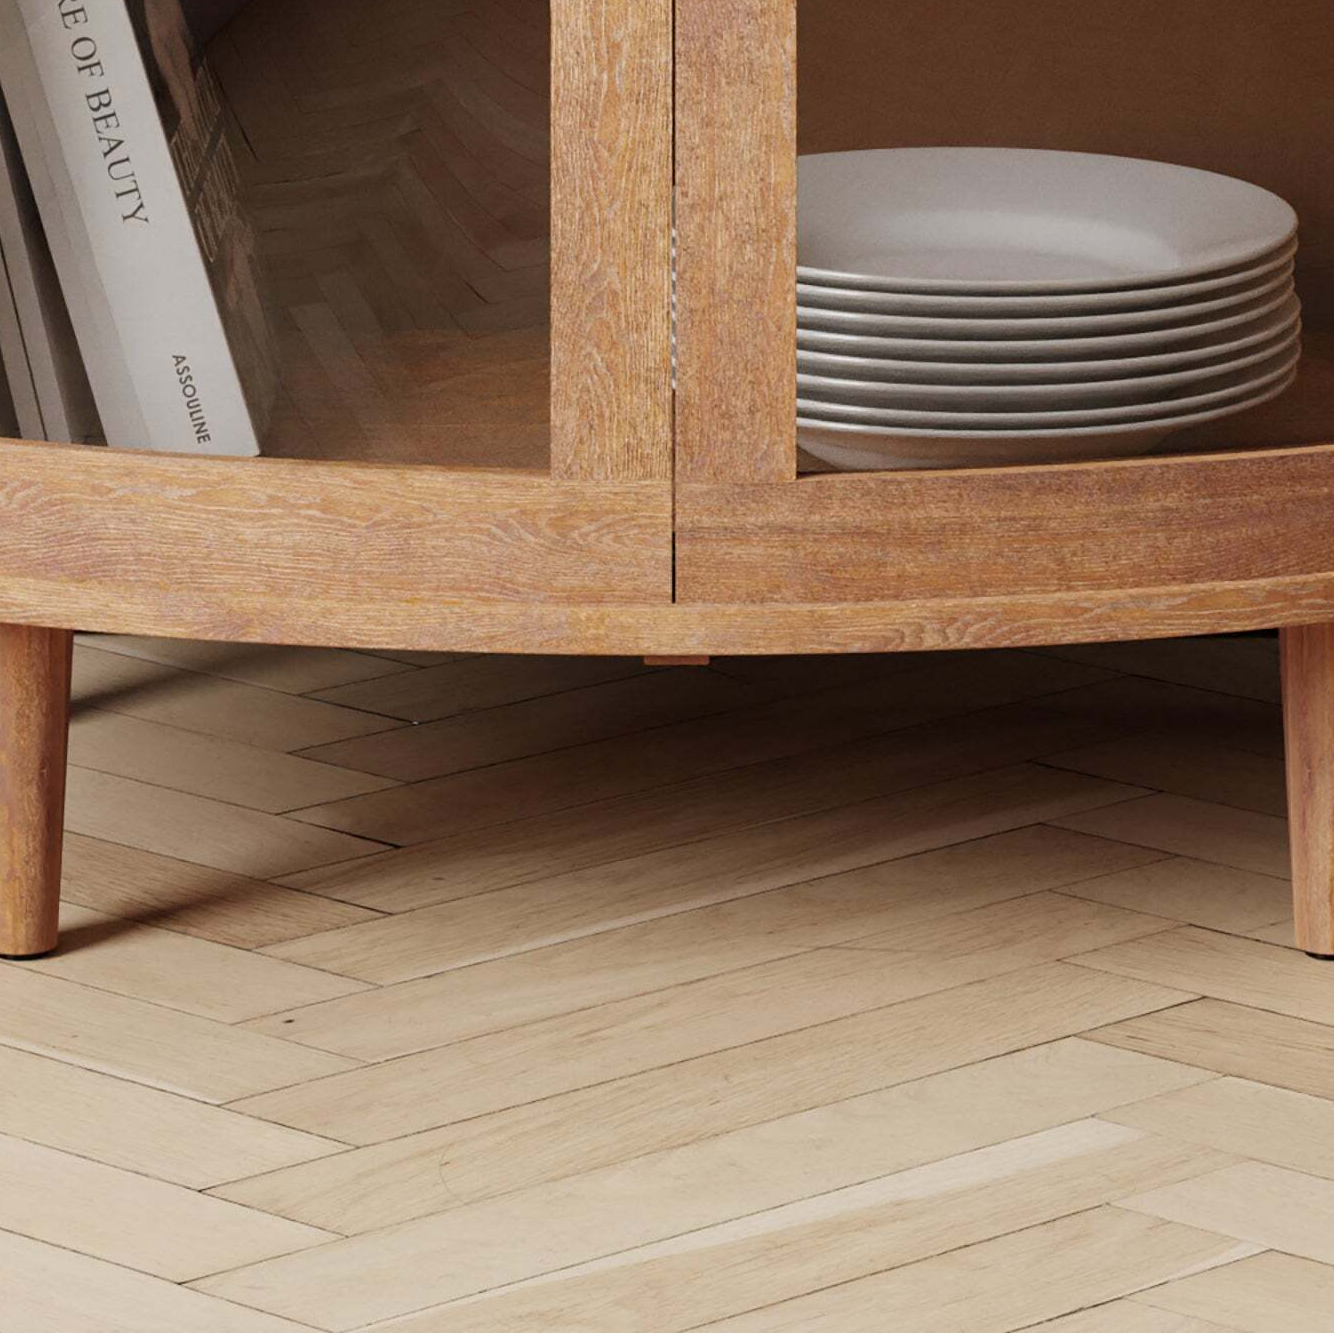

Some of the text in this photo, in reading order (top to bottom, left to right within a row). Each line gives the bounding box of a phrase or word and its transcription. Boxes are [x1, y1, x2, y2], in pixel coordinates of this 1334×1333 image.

[70, 36, 105, 79] OF
[84, 88, 149, 225] BEAUTY
[172, 354, 211, 444] ASSOULINE
